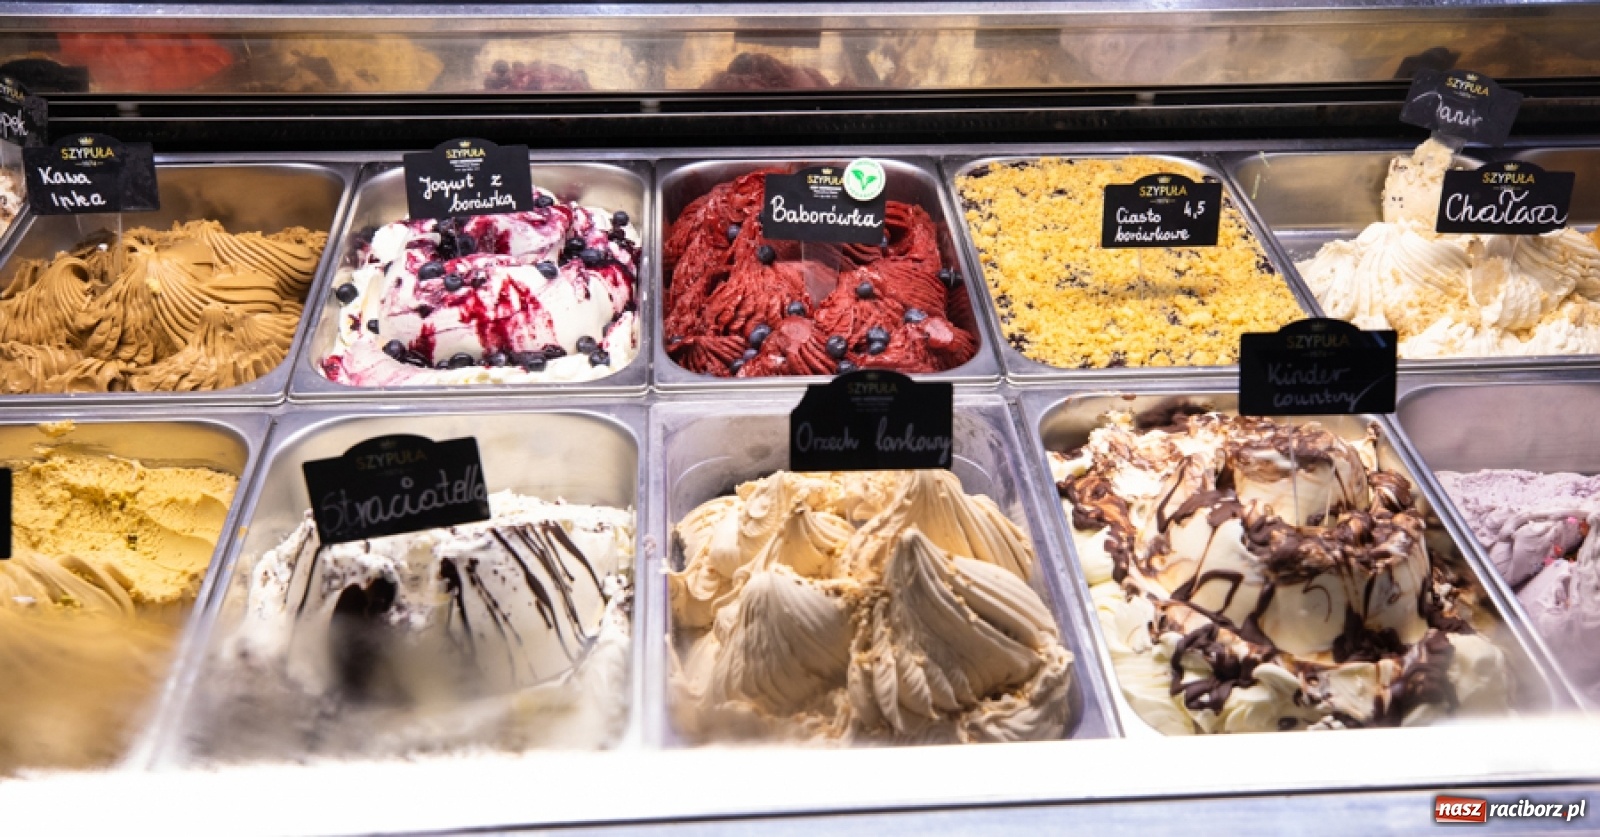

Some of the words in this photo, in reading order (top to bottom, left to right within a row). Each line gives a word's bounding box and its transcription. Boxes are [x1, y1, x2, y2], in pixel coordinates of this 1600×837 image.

[1446, 76, 1490, 97] SZYPUŁA
[61, 146, 115, 160] SZYPUŁA
[446, 148, 486, 158] SZYPUŁA
[37, 166, 92, 185] Kawa
[1482, 172, 1535, 184] SZYPUŁA
[419, 173, 474, 200] Jogurt
[490, 173, 503, 186] z
[1139, 185, 1188, 197] SZYPUŁA
[51, 190, 107, 211] Inka
[448, 190, 516, 213] borówką
[1445, 189, 1568, 225] Chałwa
[770, 195, 882, 228] Baborówka
[1116, 206, 1161, 223] Ciasto
[1183, 200, 1206, 219] 4,5
[1114, 226, 1190, 242] borówkowe
[1286, 334, 1350, 349] SZYPUŁA
[1267, 363, 1351, 385] Kinder
[847, 382, 898, 395] SZYPUŁA
[1272, 373, 1390, 412] country
[796, 421, 859, 452] Orzech
[875, 416, 952, 465] laskowy
[355, 449, 427, 470] SZYPUŁA
[320, 464, 487, 536] Straciatella
